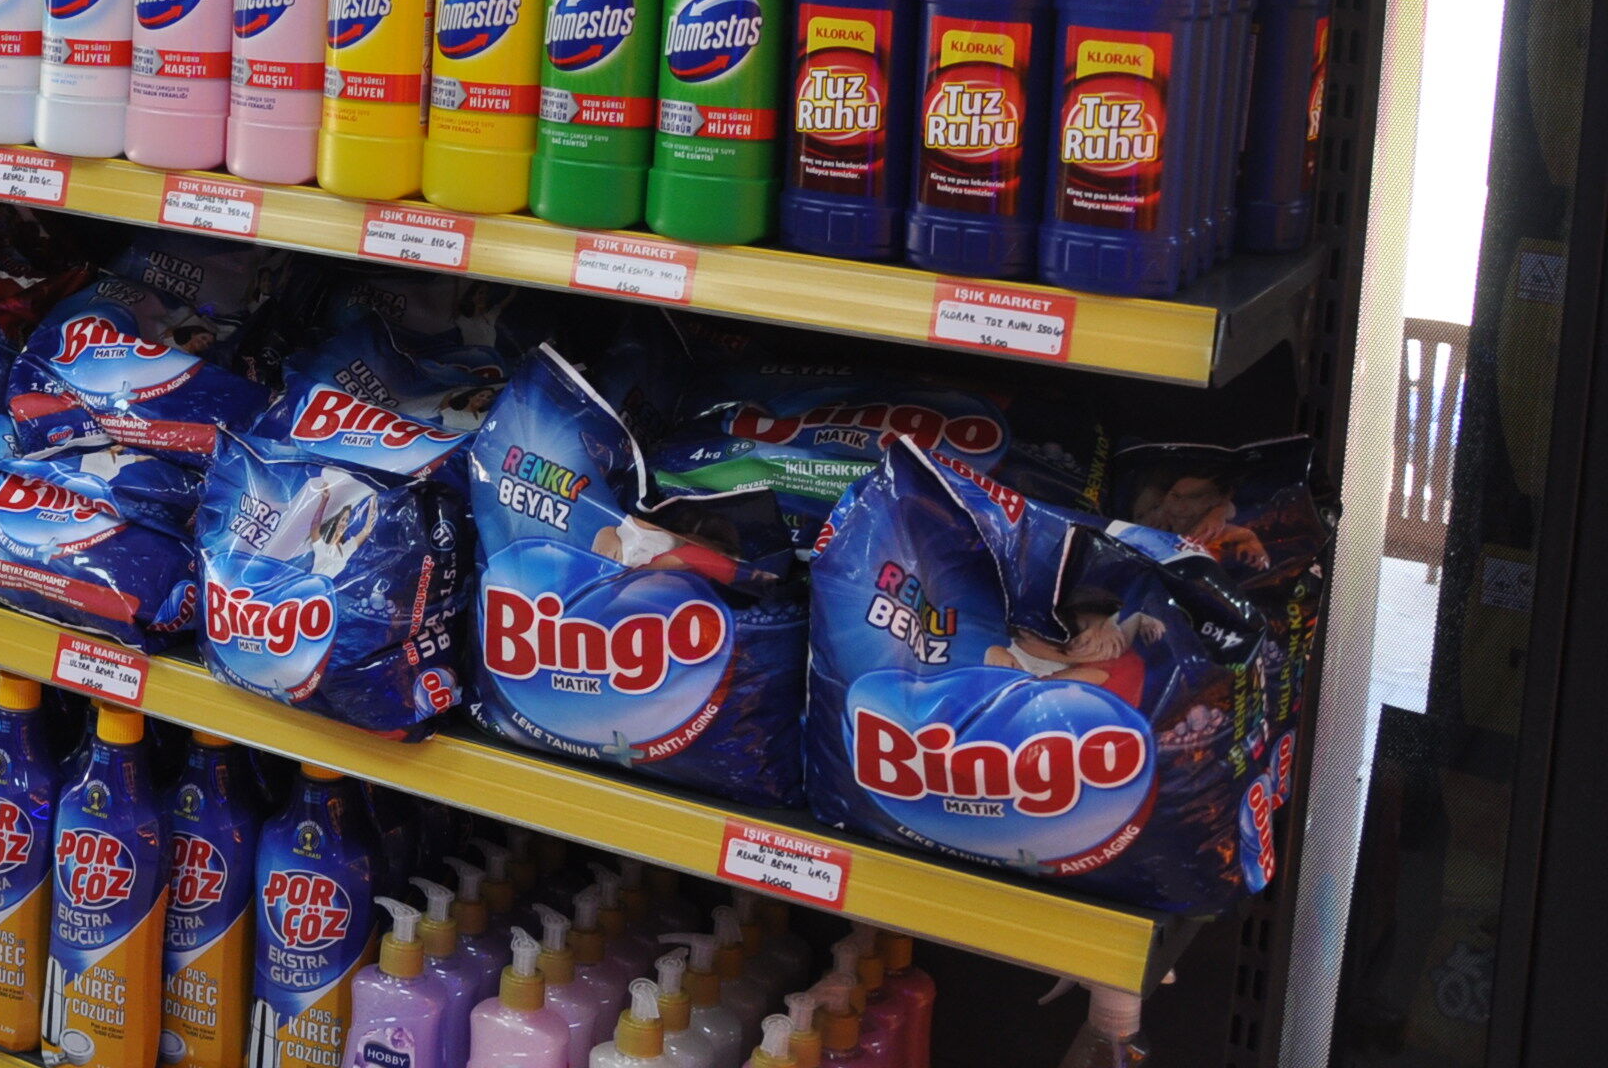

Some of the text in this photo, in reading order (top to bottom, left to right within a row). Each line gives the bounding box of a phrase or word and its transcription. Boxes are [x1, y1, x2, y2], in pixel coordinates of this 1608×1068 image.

[546, 5, 635, 45] Domestos
[815, 26, 864, 42] KLORAK
[665, 14, 762, 57] Domestos
[950, 40, 1004, 57] KLORAK
[1086, 51, 1142, 68] KLORAK
[164, 64, 207, 78] KARŞITI
[253, 74, 293, 88] KARŞITI
[811, 69, 866, 101] Tuz
[469, 96, 511, 110] HİJYEN
[582, 98, 626, 110] UZUN SÜRELİ
[944, 83, 1003, 116] Tuz
[582, 109, 624, 123] HİJYEN
[708, 112, 753, 122] UZUN SÜRELİ
[797, 100, 880, 132] Ruhu
[1080, 94, 1144, 130] Tuz
[708, 121, 752, 136] HİJYEN
[926, 115, 1018, 149] Ruhu
[1062, 128, 1158, 162] Ruhu
[16, 155, 56, 168] MARKET
[1066, 187, 1089, 199] Kireç
[1100, 192, 1113, 203] pas
[1114, 192, 1145, 205] lekelerini
[1073, 198, 1135, 213] kolayca temizler.
[955, 288, 1052, 311] IŞIK MARKET
[815, 431, 868, 447] MATİK
[502, 446, 590, 501] RENKLİ
[785, 461, 840, 476] İKİLİ RENK
[498, 481, 571, 530] BEYAZ
[5, 564, 26, 579] BEYAZ
[485, 586, 725, 694] Bingo
[551, 674, 601, 693] MATİK
[648, 702, 719, 758] ANTI-AGING
[854, 707, 1146, 817] Bingo
[945, 800, 1004, 816] MATİK
[56, 831, 121, 868] POR
[896, 825, 1002, 869] LEKE TANIMA
[70, 866, 134, 906] ÇÖZ
[58, 903, 112, 928] EKSTRA
[58, 922, 105, 946] GÜÇLÜ
[93, 966, 116, 982] PAS
[186, 967, 207, 982] PAS
[270, 966, 321, 988] GÜÇLÜ
[73, 974, 127, 1005] KİREÇ
[309, 1008, 332, 1024] PAS
[366, 1047, 407, 1066] HOBBY
